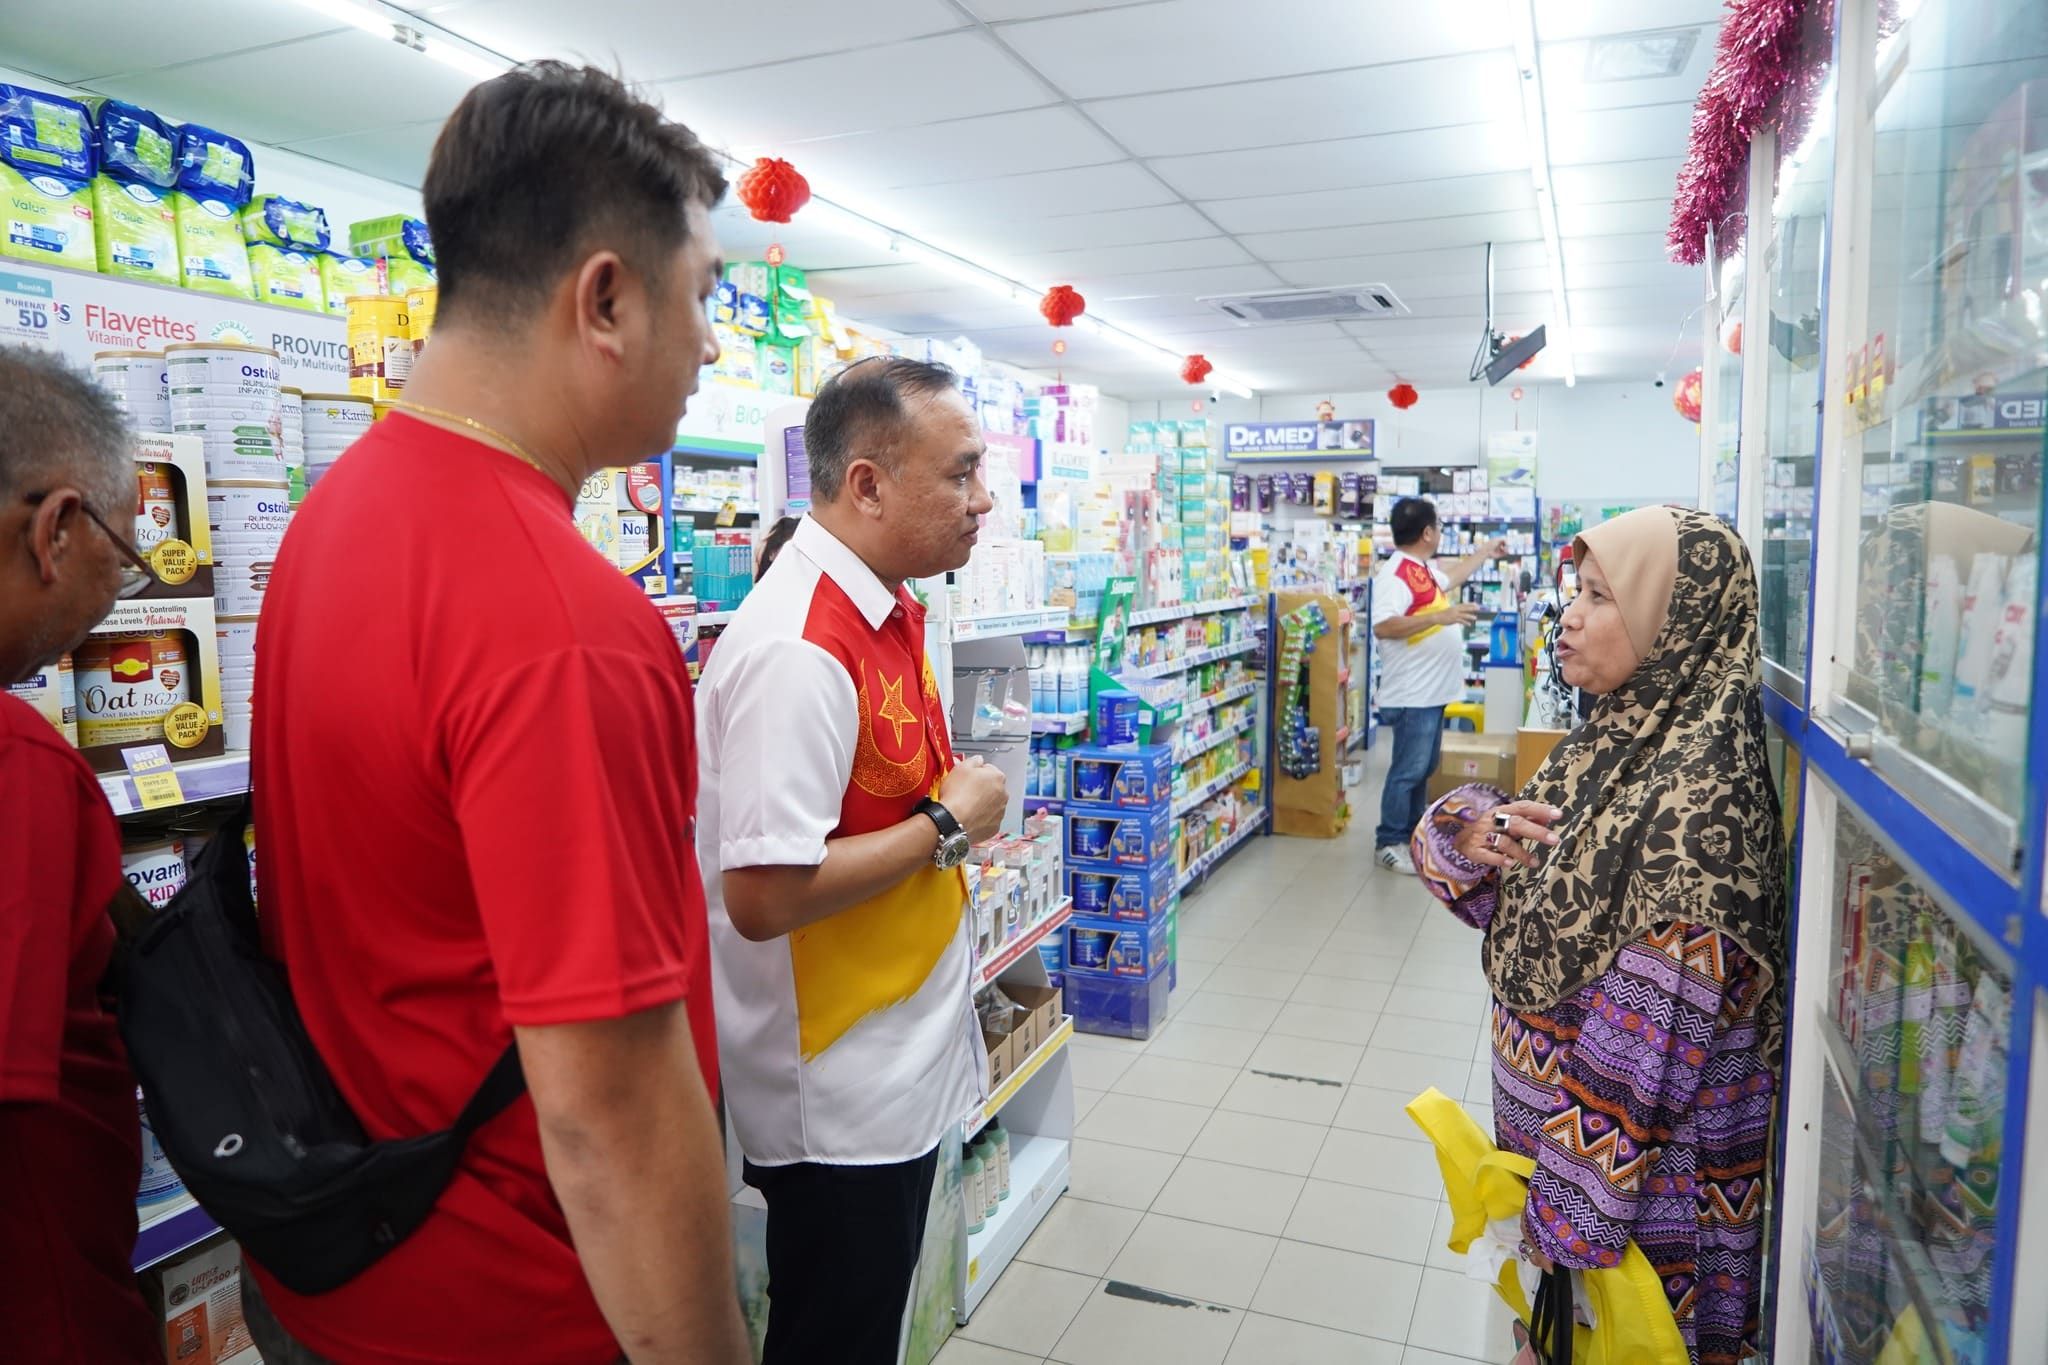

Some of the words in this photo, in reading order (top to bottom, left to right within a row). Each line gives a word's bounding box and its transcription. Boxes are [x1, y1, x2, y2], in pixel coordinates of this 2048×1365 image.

[12, 197, 48, 215] Value
[113, 207, 145, 225] Value
[14, 222, 23, 231] M
[185, 223, 215, 237] Value
[5, 298, 46, 310] PURENAT
[19, 309, 48, 328] 5D
[85, 304, 196, 342] Flavettes
[87, 330, 133, 348] Vitamin
[136, 336, 146, 350] C
[1229, 426, 1313, 447] Dr.MED
[162, 549, 186, 558] SUPER
[163, 558, 187, 567] VALUE
[166, 567, 186, 576] PACK
[149, 605, 188, 614] Controlling
[120, 617, 143, 625] Levels
[144, 614, 187, 627] Naturally
[85, 684, 137, 715] Oat
[144, 692, 178, 707] BG22
[102, 711, 117, 719] OAT
[175, 712, 198, 721] SUPER
[175, 721, 198, 730] VALUE
[178, 730, 198, 739] PACK
[134, 750, 158, 762] BEST
[132, 757, 168, 773] SELLER
[150, 884, 177, 903] KID
